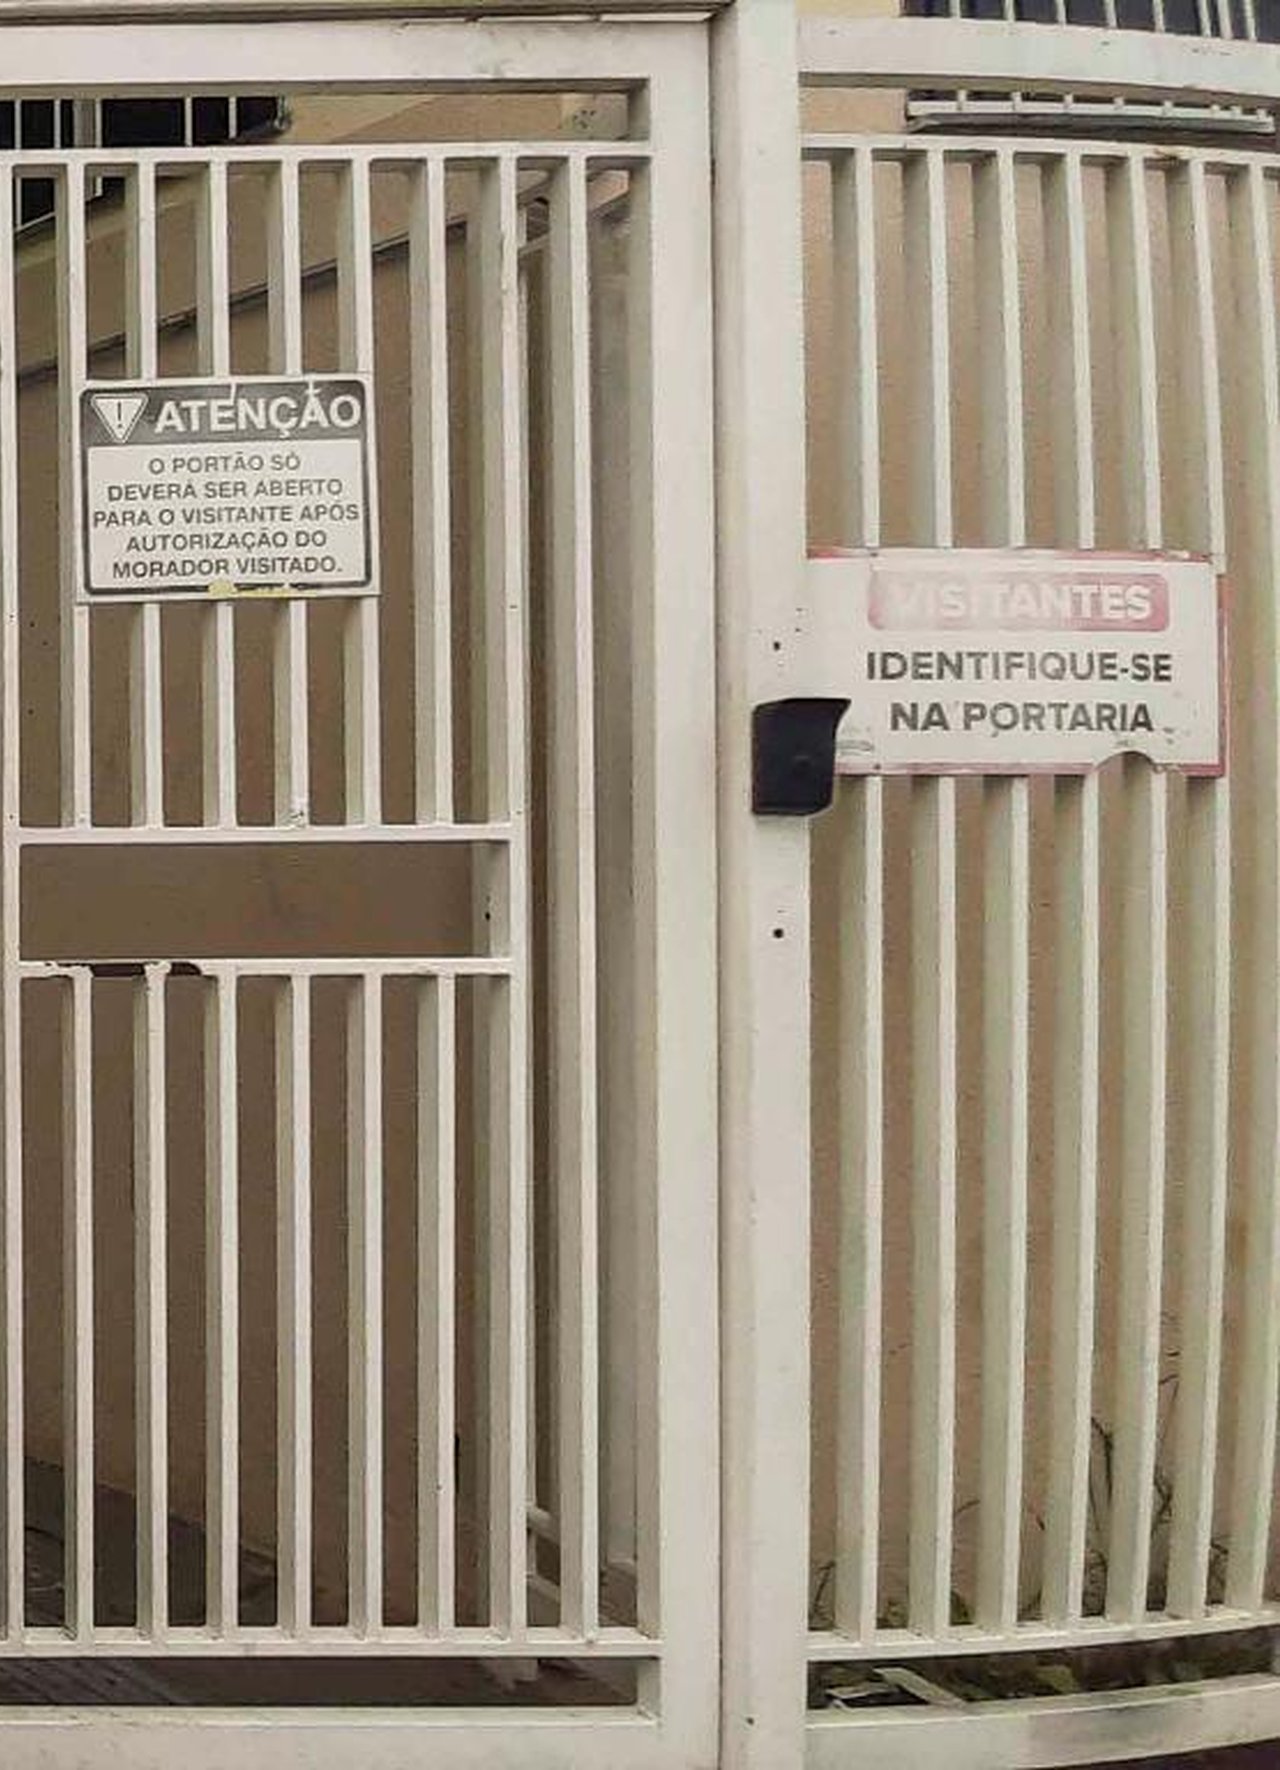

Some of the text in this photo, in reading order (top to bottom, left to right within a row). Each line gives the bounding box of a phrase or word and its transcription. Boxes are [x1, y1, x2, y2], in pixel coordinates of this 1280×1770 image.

[154, 387, 362, 438] ATENÇÃO
[148, 451, 300, 475] O PORTÃO SÓ
[204, 481, 247, 499] SER
[253, 478, 343, 497] ABERTO
[93, 510, 153, 528] PARA
[158, 508, 175, 526] O
[181, 506, 293, 525] VISITANTE
[125, 526, 327, 552] AUTORIZAÇÃO DO
[112, 555, 343, 579] MORADOR VISITADO.
[890, 584, 1152, 621] VISITANTES
[866, 650, 1173, 682] IDENTIFIQUE-SE
[891, 702, 1154, 732] NA PORTARIA
